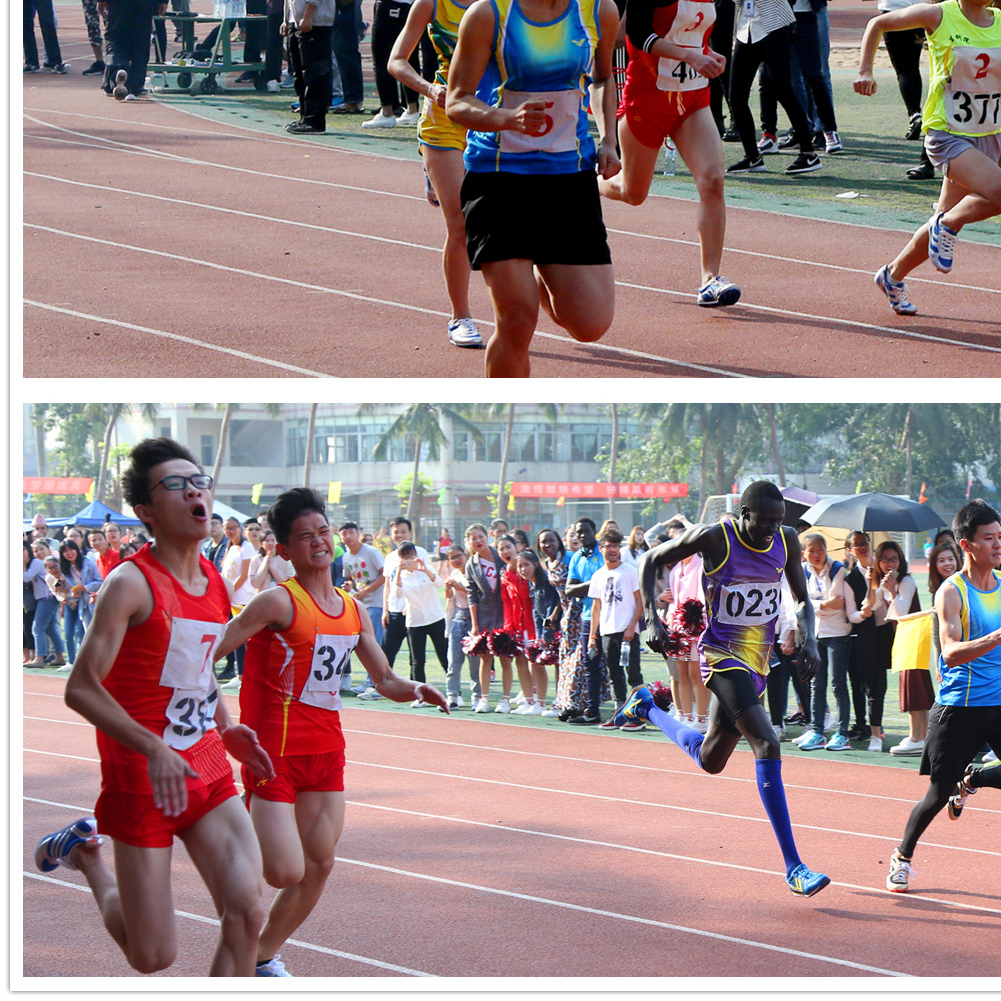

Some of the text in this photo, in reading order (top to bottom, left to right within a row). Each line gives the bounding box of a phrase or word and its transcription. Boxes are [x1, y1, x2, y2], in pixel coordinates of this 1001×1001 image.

[683, 11, 705, 32] 3
[671, 60, 703, 83] 40
[974, 52, 991, 79] 2
[952, 90, 1001, 124] 377
[725, 587, 778, 618] 023
[200, 633, 217, 674] 7
[313, 644, 357, 682] 34
